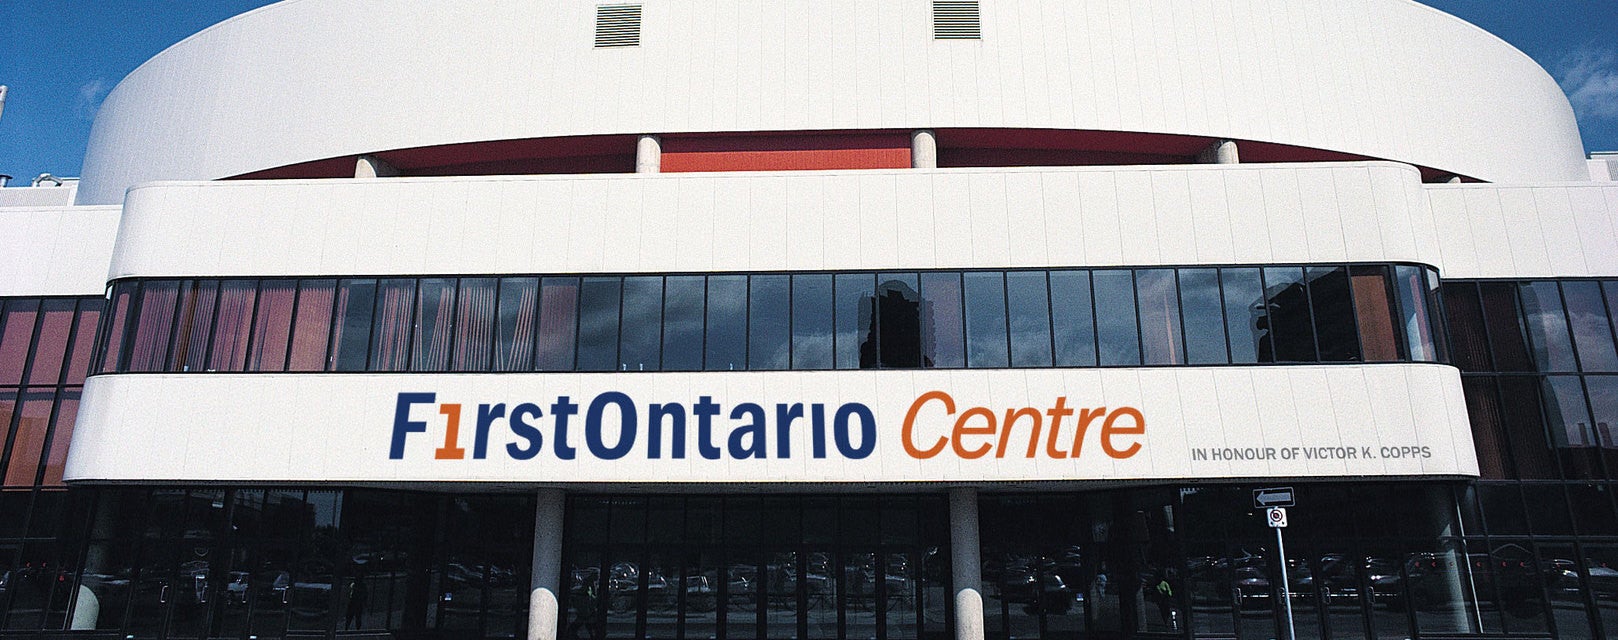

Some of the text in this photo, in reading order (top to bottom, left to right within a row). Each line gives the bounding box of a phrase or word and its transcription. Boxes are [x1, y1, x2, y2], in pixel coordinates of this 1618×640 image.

[901, 390, 1146, 460] Centre
[1191, 446, 1432, 461] IN HONOUR OF VICTOR K. COPPS
